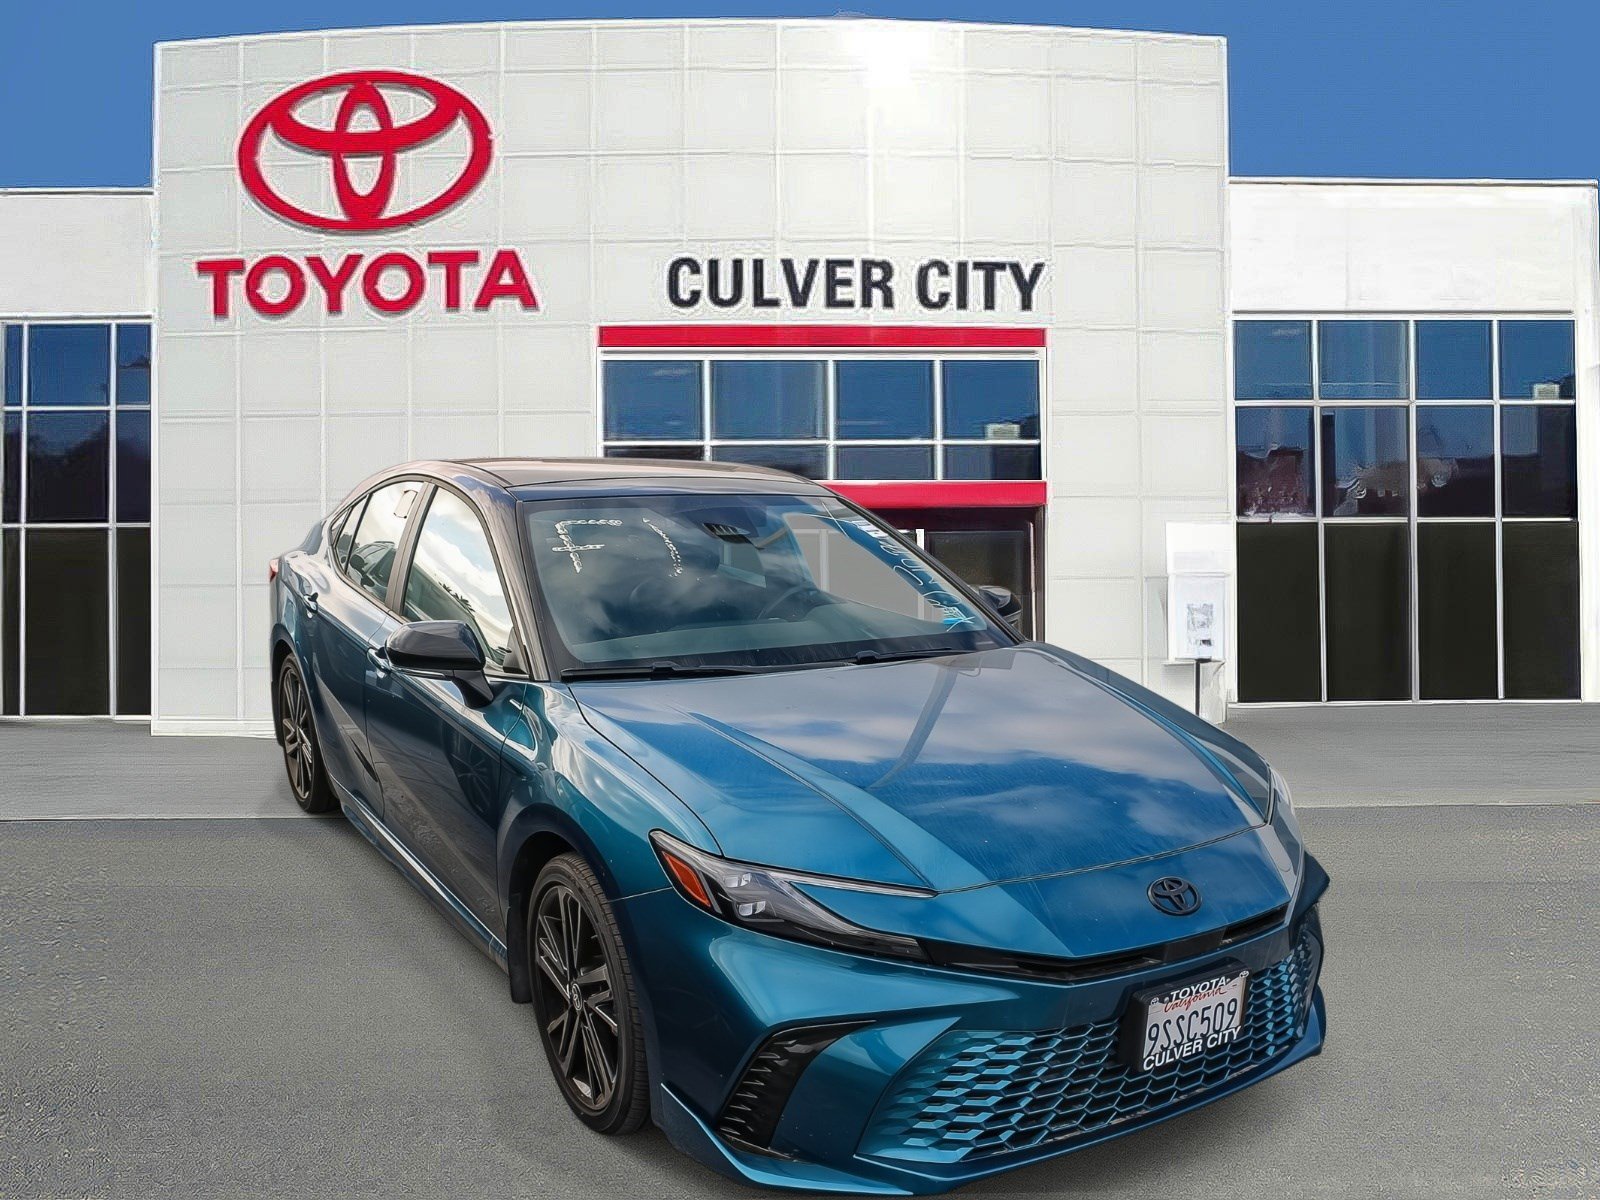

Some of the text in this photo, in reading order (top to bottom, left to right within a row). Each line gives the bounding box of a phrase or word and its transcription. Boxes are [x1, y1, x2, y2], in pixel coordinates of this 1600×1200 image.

[196, 249, 539, 319] TOYOTA
[667, 257, 1045, 312] CULVER CITY
[1164, 987, 1227, 1013] California
[1170, 976, 1227, 1003] TOYOTA
[1143, 1025, 1241, 1071] CULVER CITY
[1145, 998, 1238, 1057] 9SSC509
